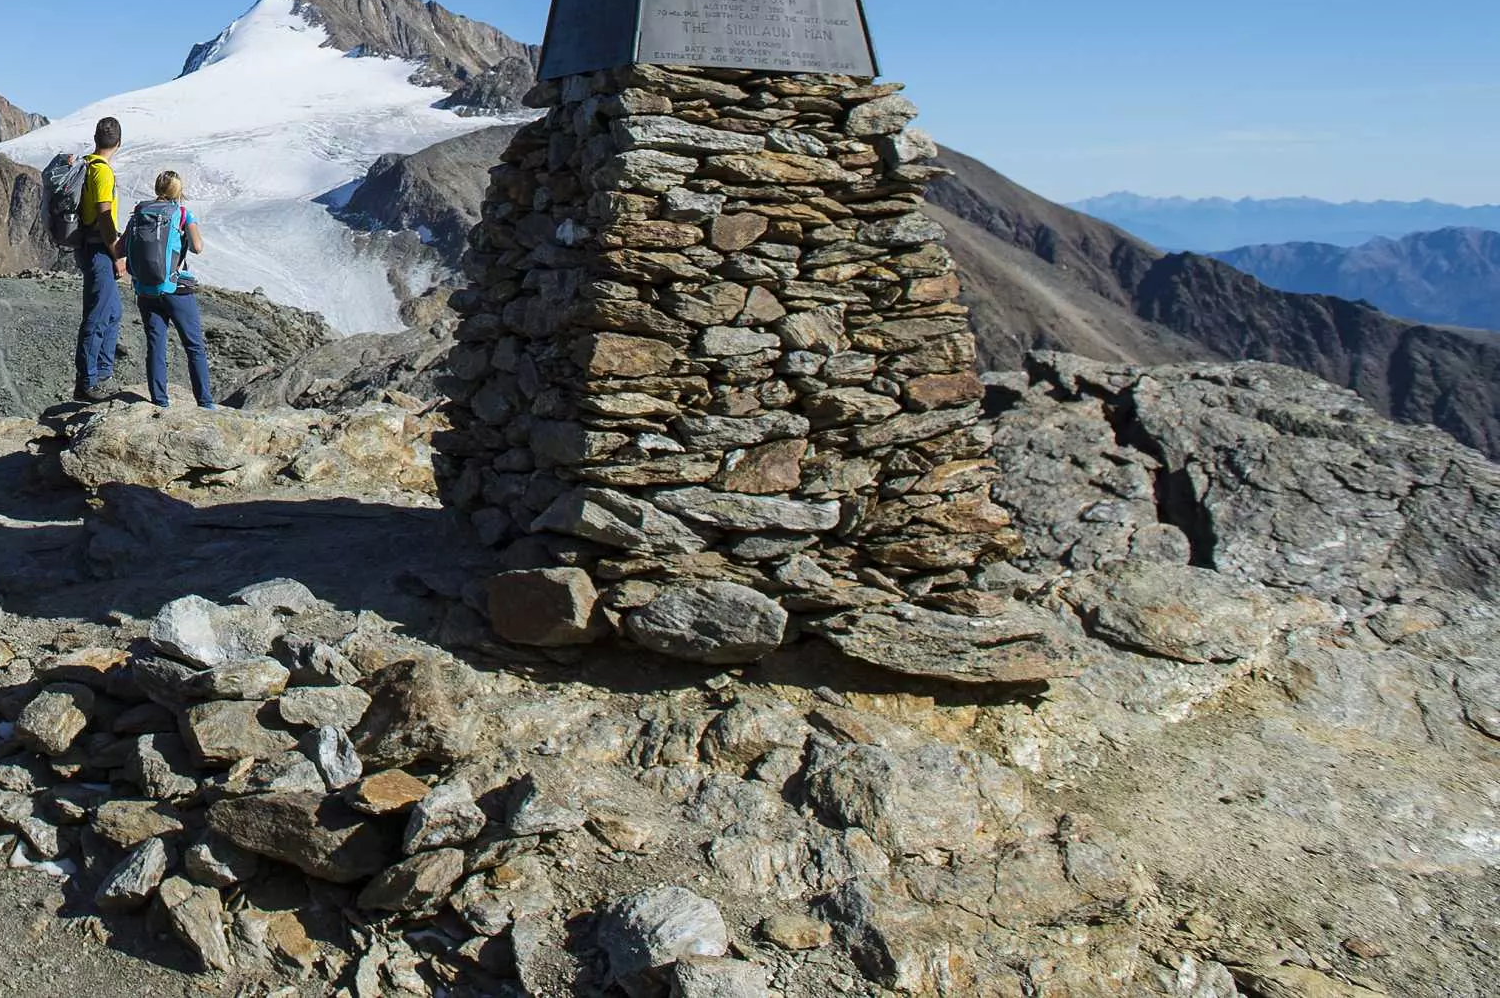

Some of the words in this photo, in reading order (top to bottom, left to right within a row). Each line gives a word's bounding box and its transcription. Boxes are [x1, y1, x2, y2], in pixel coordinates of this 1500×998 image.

[682, 21, 710, 34] THE
[726, 23, 791, 38] SIMILAUN
[804, 28, 833, 41] MAN
[684, 45, 706, 53] DATE
[654, 51, 704, 61] ESTIMATED
